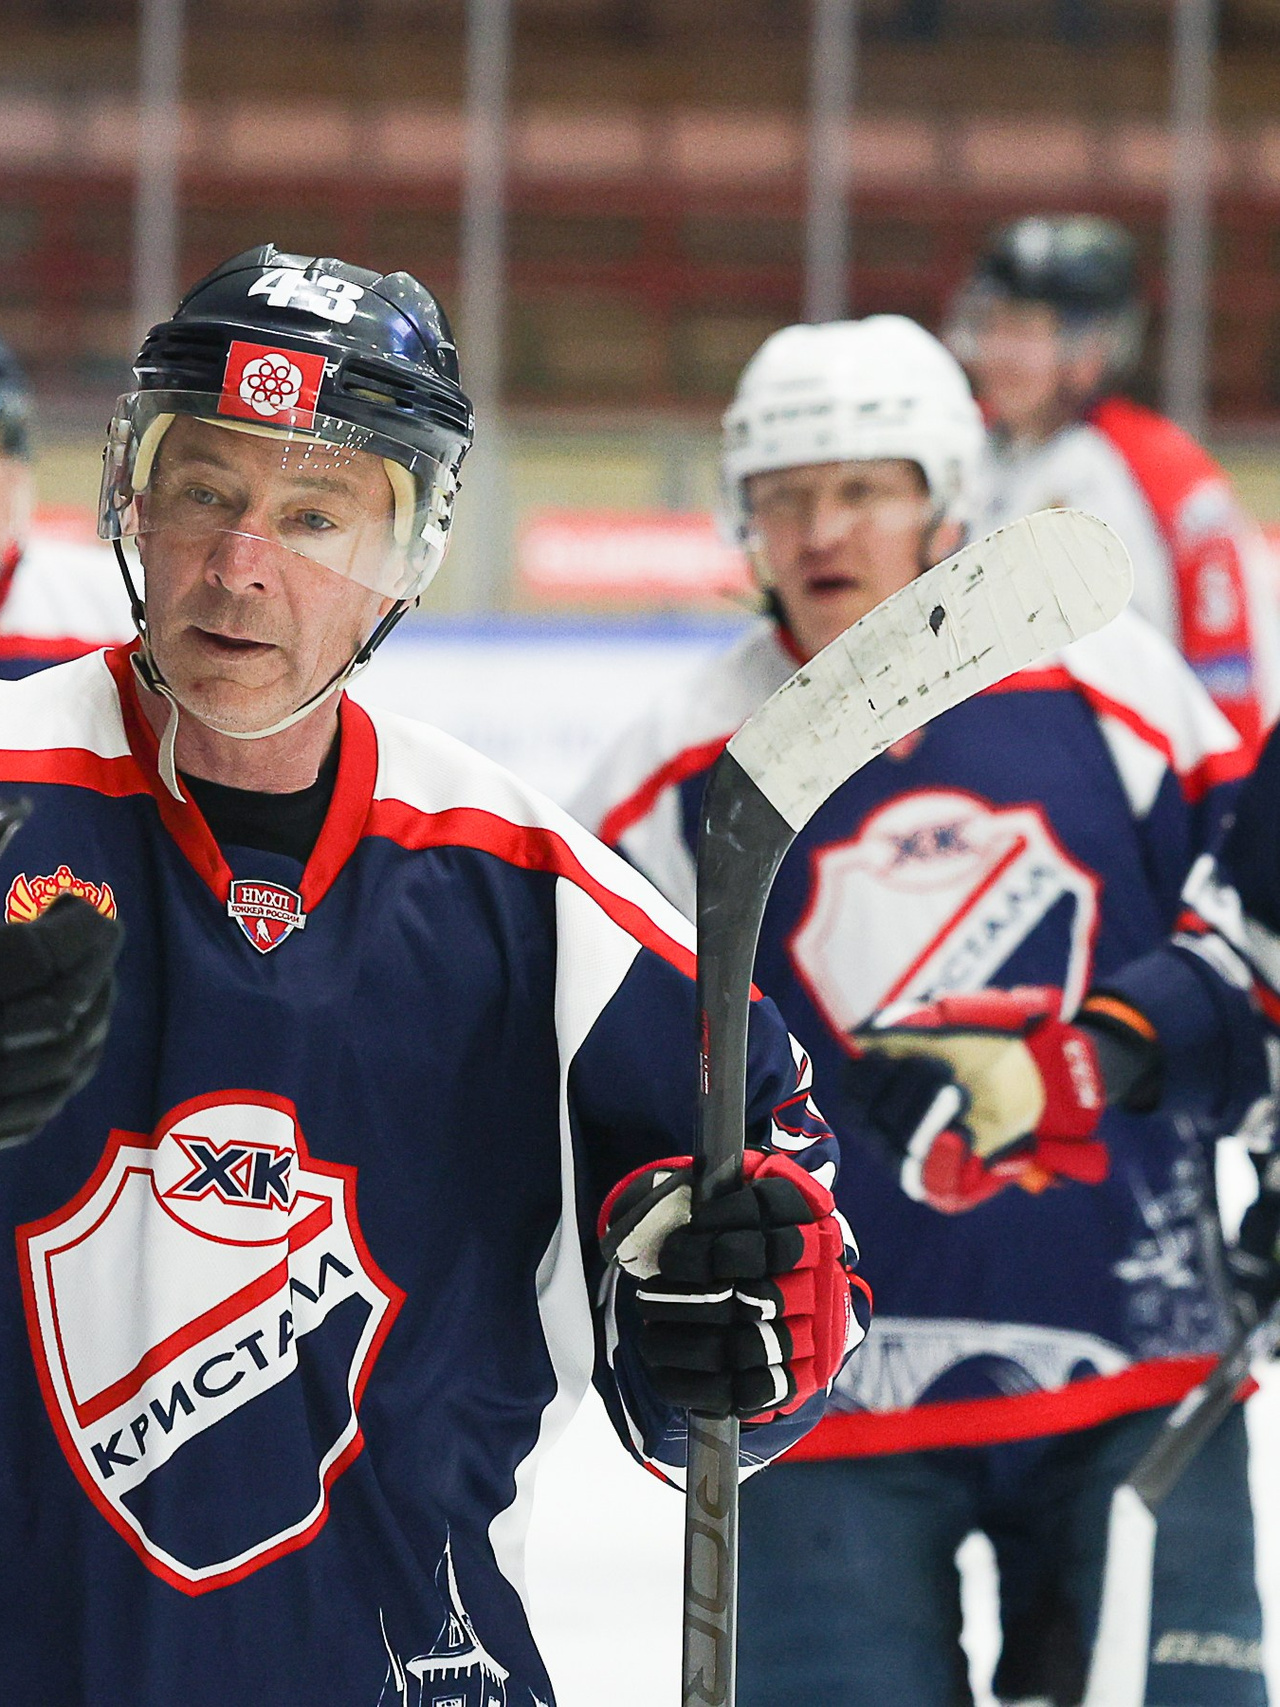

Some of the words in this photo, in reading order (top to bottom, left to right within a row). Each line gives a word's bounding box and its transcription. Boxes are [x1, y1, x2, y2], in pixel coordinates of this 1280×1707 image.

[247, 266, 365, 325] 43
[266, 908, 300, 923] РОССИИ
[172, 1138, 295, 1207] ХК
